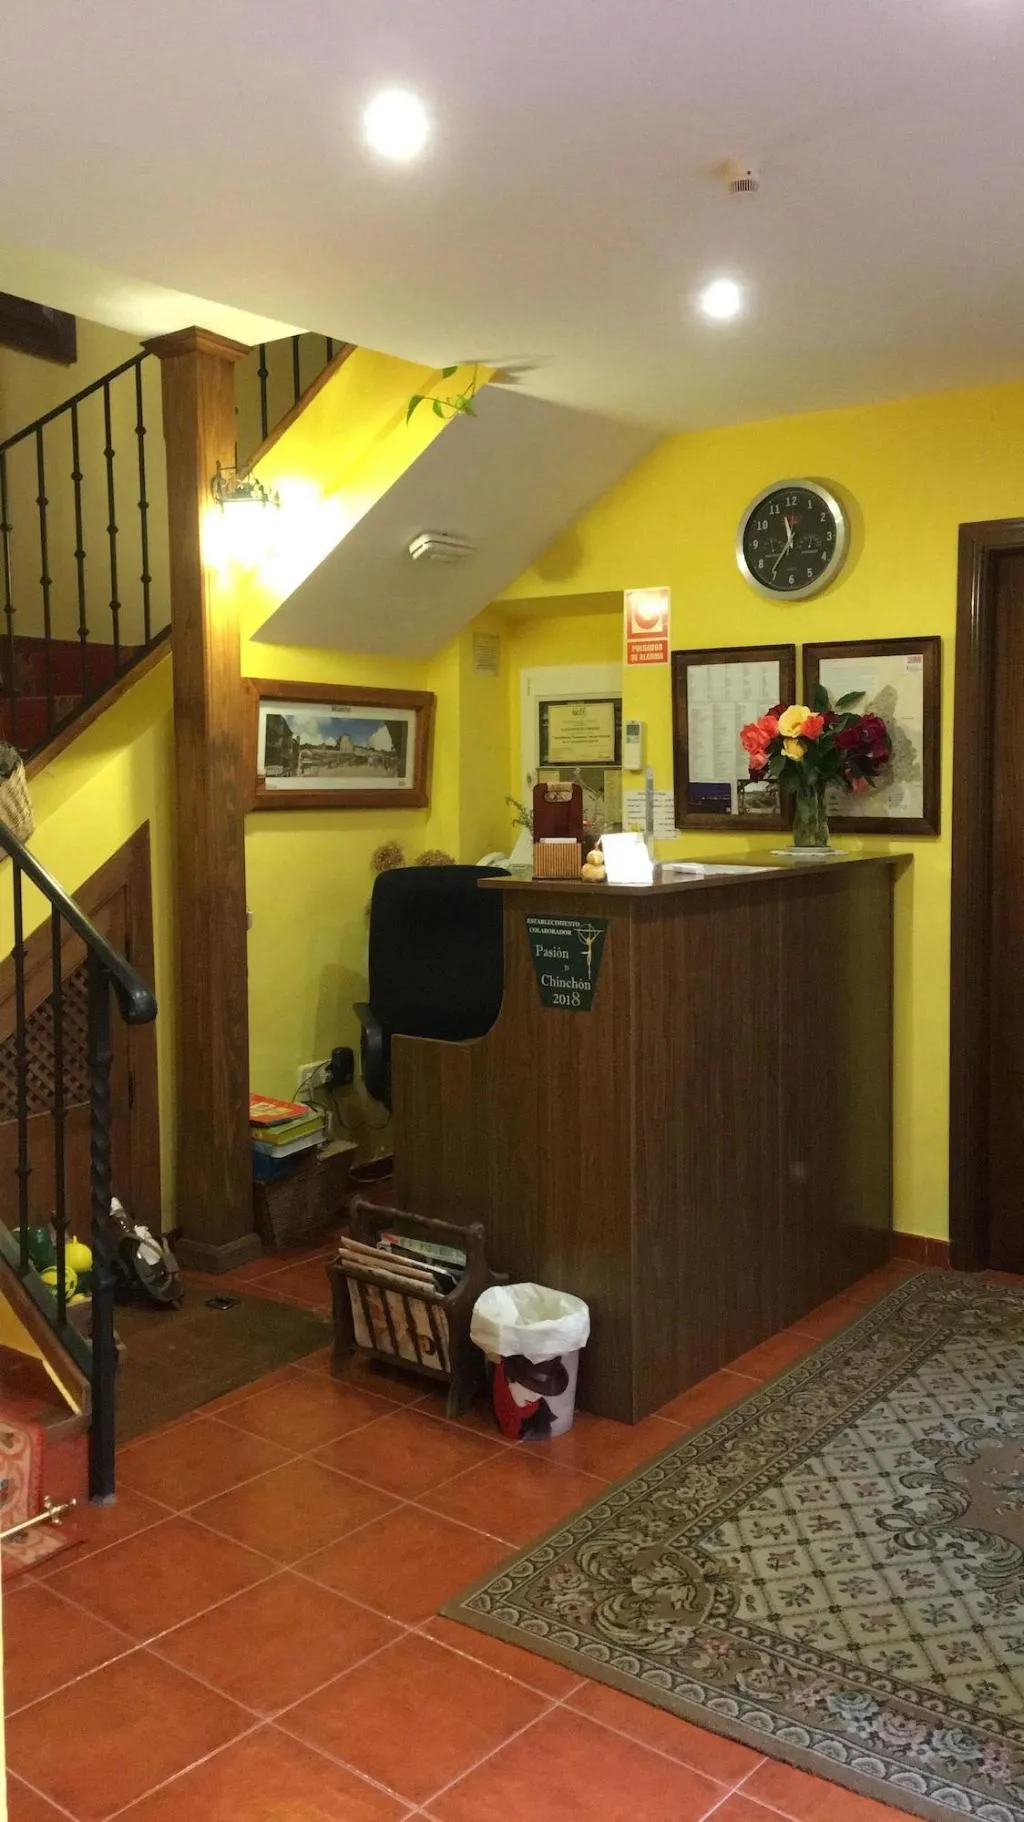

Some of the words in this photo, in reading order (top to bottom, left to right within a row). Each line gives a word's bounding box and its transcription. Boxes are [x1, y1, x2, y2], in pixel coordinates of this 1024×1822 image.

[785, 496, 797, 506] 12
[807, 500, 812, 509] 1
[769, 504, 780, 515] 11
[820, 512, 826, 522] 2
[757, 520, 768, 531] 10
[826, 531, 832, 541] 3
[752, 540, 758, 549] 9
[821, 552, 827, 561] 4
[758, 559, 764, 568] 8
[807, 568, 813, 577] 5
[788, 575, 794, 584] 6
[526, 918, 581, 927] ESTABLECIMIENTO
[529, 927, 572, 936] COLABORADOR
[535, 944, 569, 959] Pasión
[541, 974, 591, 990] Chinchón
[552, 991, 581, 1007] 2018
